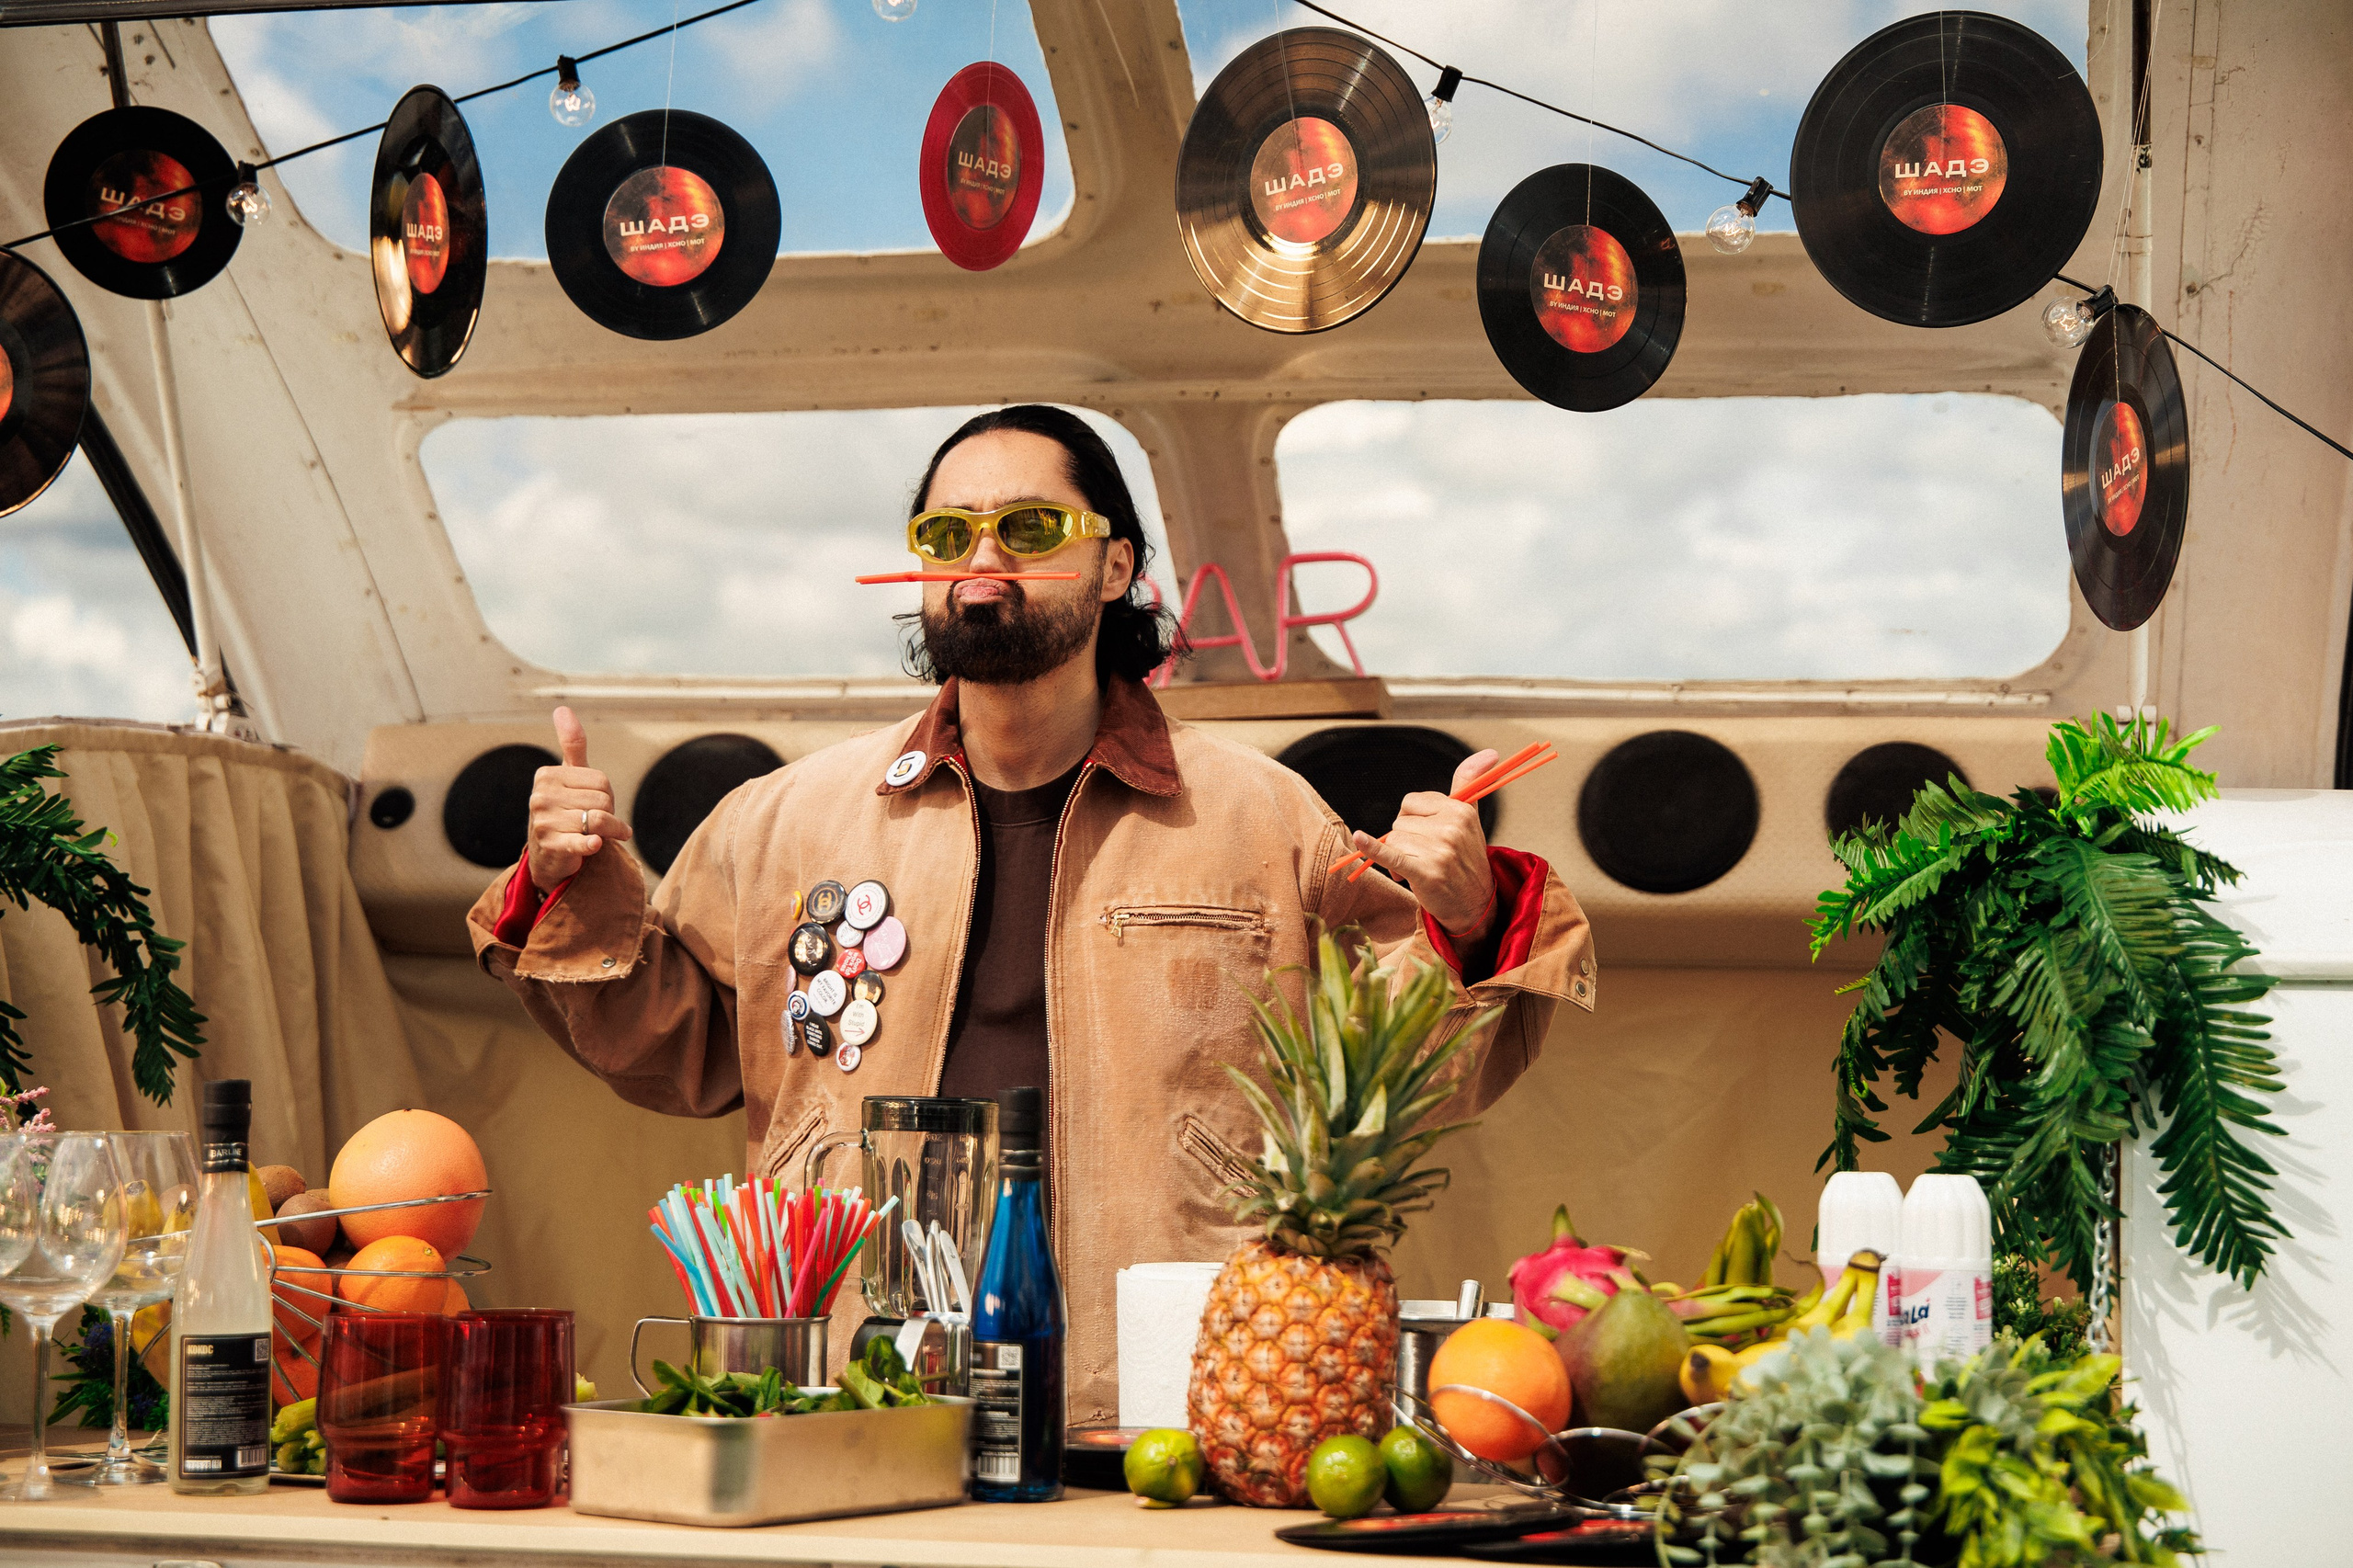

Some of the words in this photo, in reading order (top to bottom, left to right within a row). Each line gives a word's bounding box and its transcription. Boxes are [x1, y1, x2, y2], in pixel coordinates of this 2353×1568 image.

[958, 151, 1012, 179] ШАДЭ
[1894, 158, 1990, 179] ШАДЭ
[1265, 162, 1344, 196] ШАДЭ
[1913, 187, 1938, 196] ИНДИЯ
[1283, 198, 1304, 209] ИНДИЯ
[406, 222, 443, 242] ШАДЭ
[620, 213, 710, 236] ШАДЭ
[1543, 272, 1623, 301] ШАДЭ
[1558, 301, 1579, 312] ИНДИЯ
[2101, 447, 2140, 490] ШАДЭ
[847, 1019, 865, 1028] Stupid
[210, 1148, 243, 1158] BARLINE
